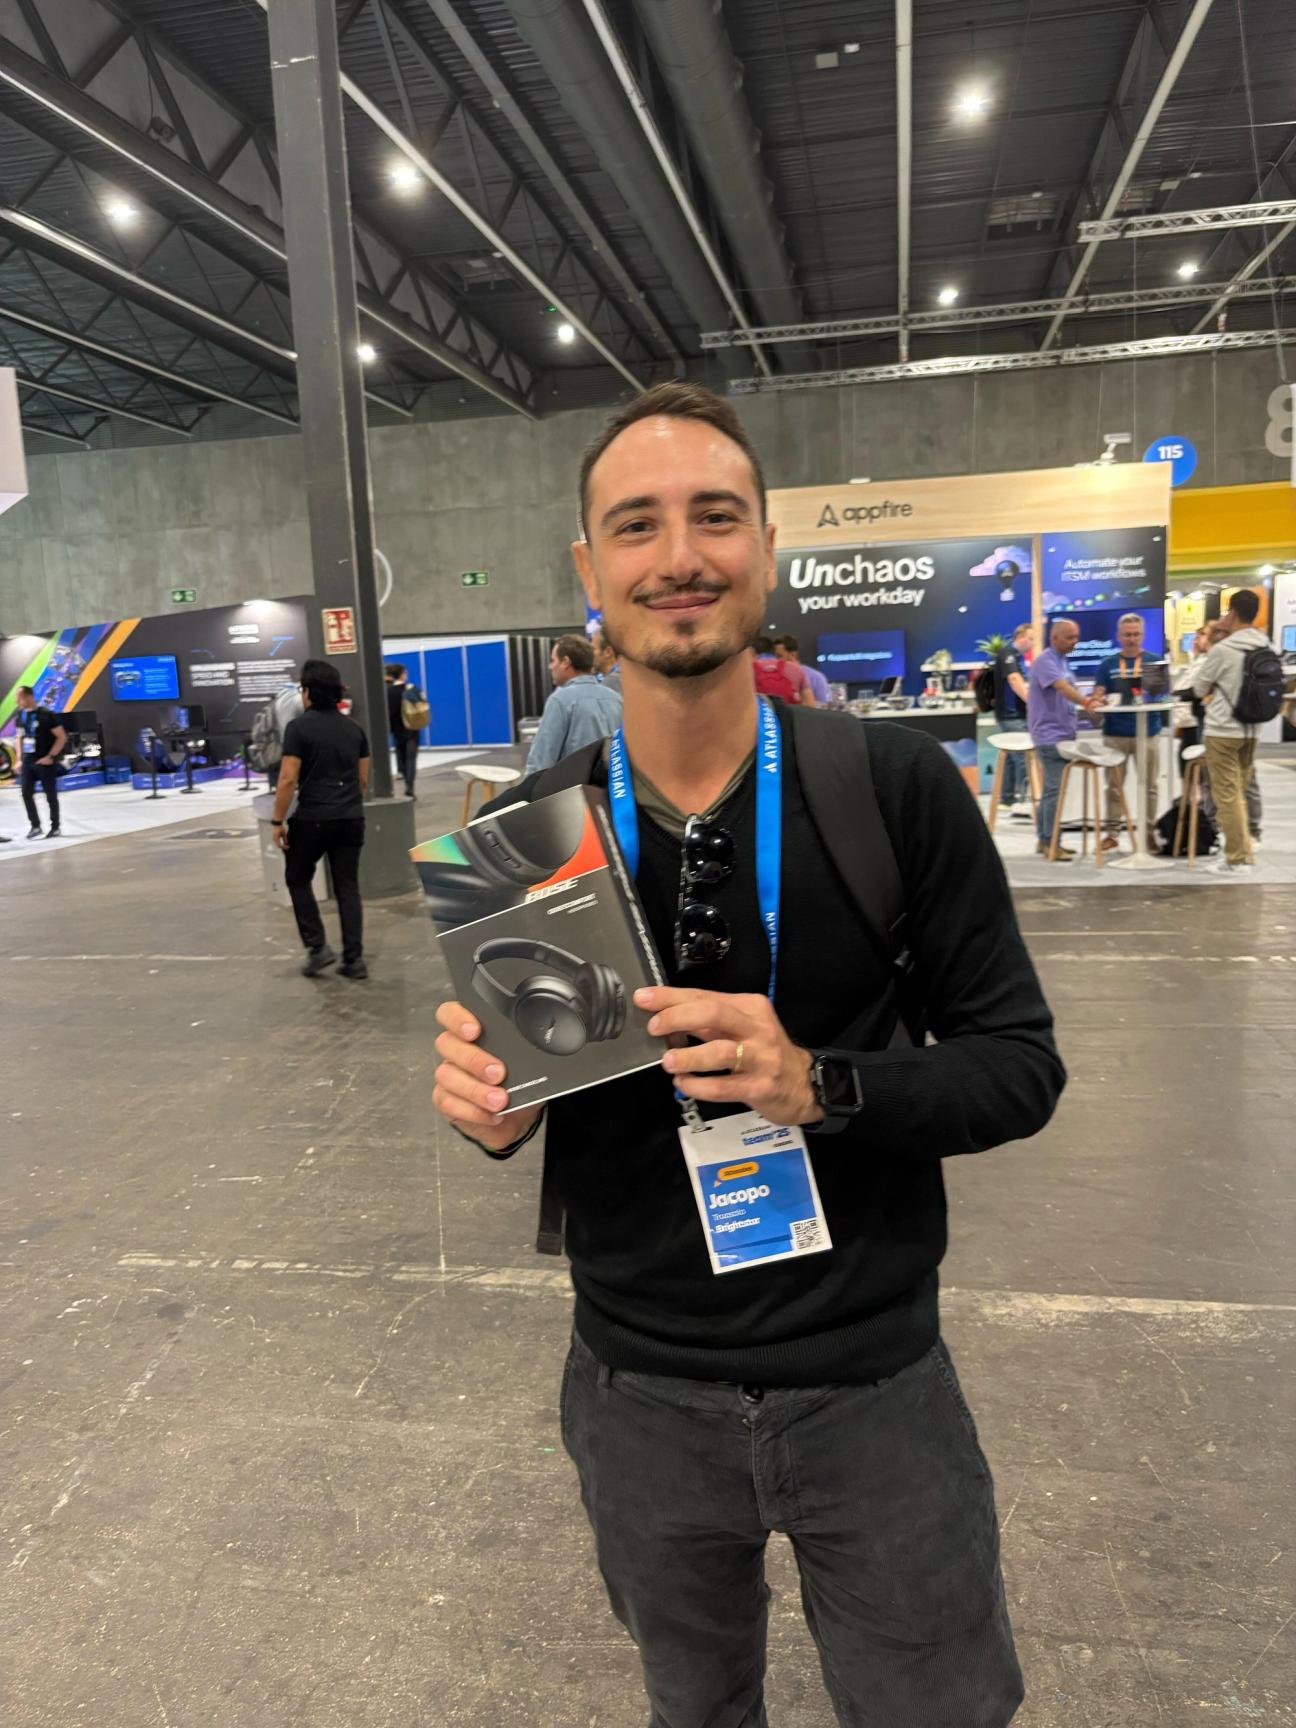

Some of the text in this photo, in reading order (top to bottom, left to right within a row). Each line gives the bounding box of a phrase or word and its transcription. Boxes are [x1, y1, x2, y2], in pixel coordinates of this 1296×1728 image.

[1157, 444, 1185, 460] 115
[842, 500, 913, 524] appfire
[789, 554, 936, 589] Unchaos
[798, 586, 926, 614] your workday
[610, 738, 627, 799] ATLASSIAN
[525, 878, 579, 904] BOSE
[709, 1184, 770, 1209] Jacopo
